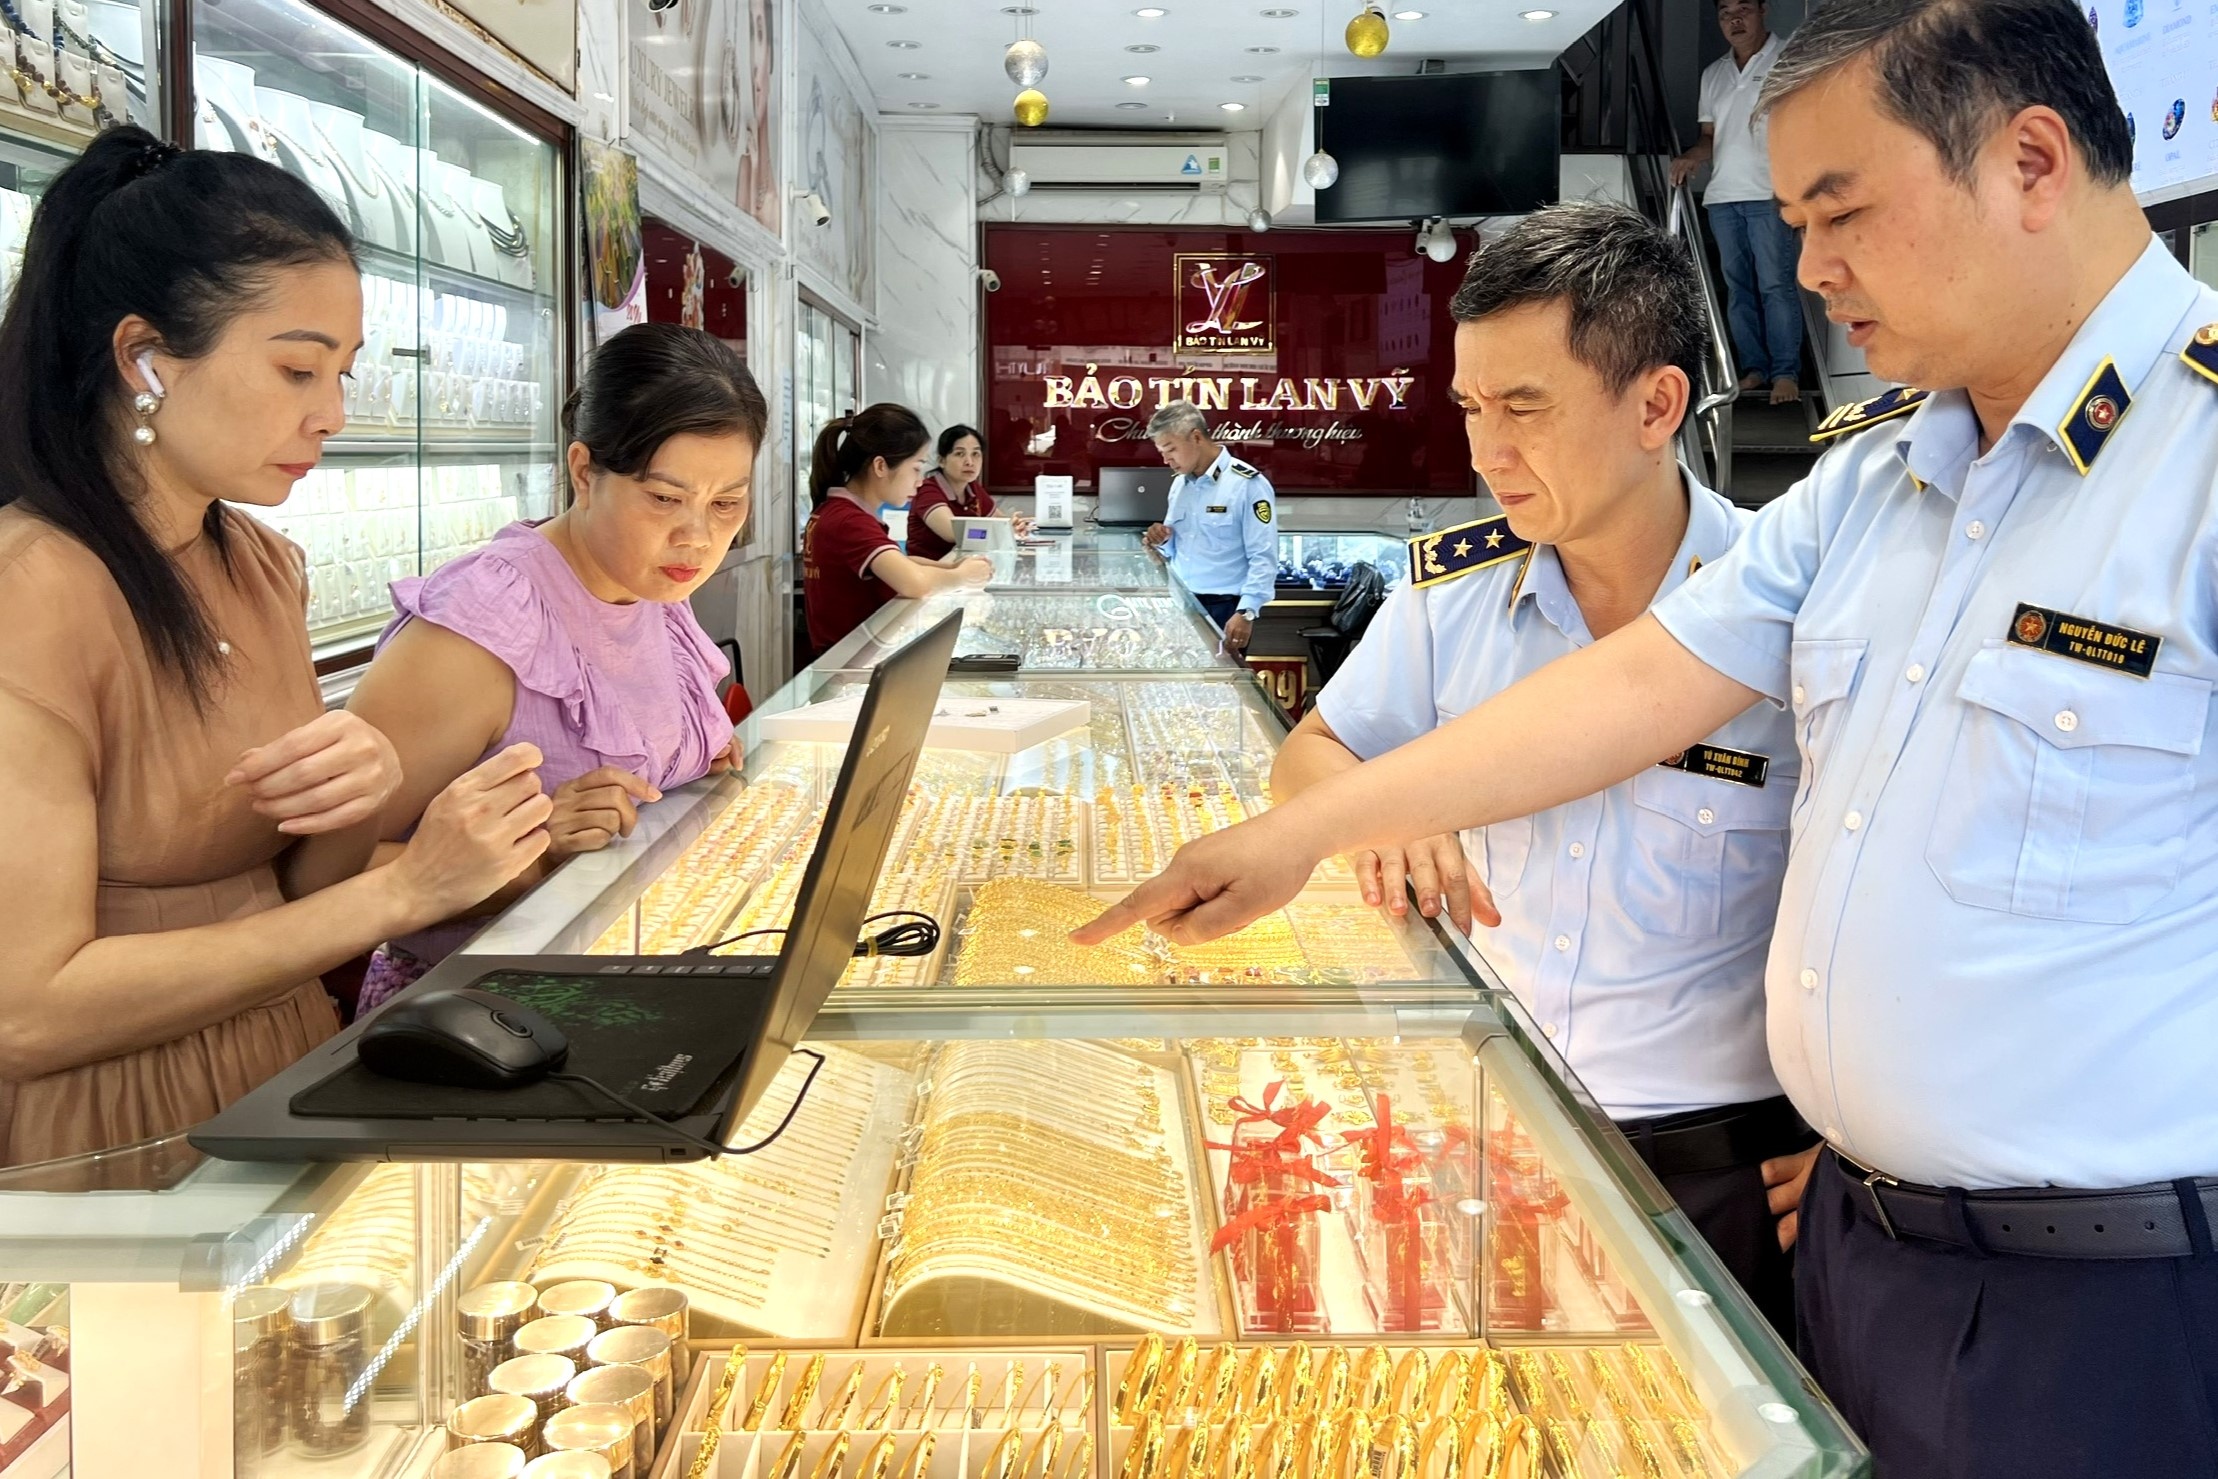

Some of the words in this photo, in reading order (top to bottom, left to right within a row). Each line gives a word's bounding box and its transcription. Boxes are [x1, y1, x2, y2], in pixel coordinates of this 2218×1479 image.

[629, 40, 663, 97] UXURY
[1043, 363, 1144, 410] BẢO
[1148, 365, 1234, 411] TÍN
[1240, 378, 1341, 412] LAN
[1347, 367, 1416, 412] VỸ
[1211, 421, 1264, 446] thành
[2058, 621, 2101, 643] NGUYỄN
[2105, 630, 2128, 649] ĐỨC
[2130, 638, 2147, 654] LÊ
